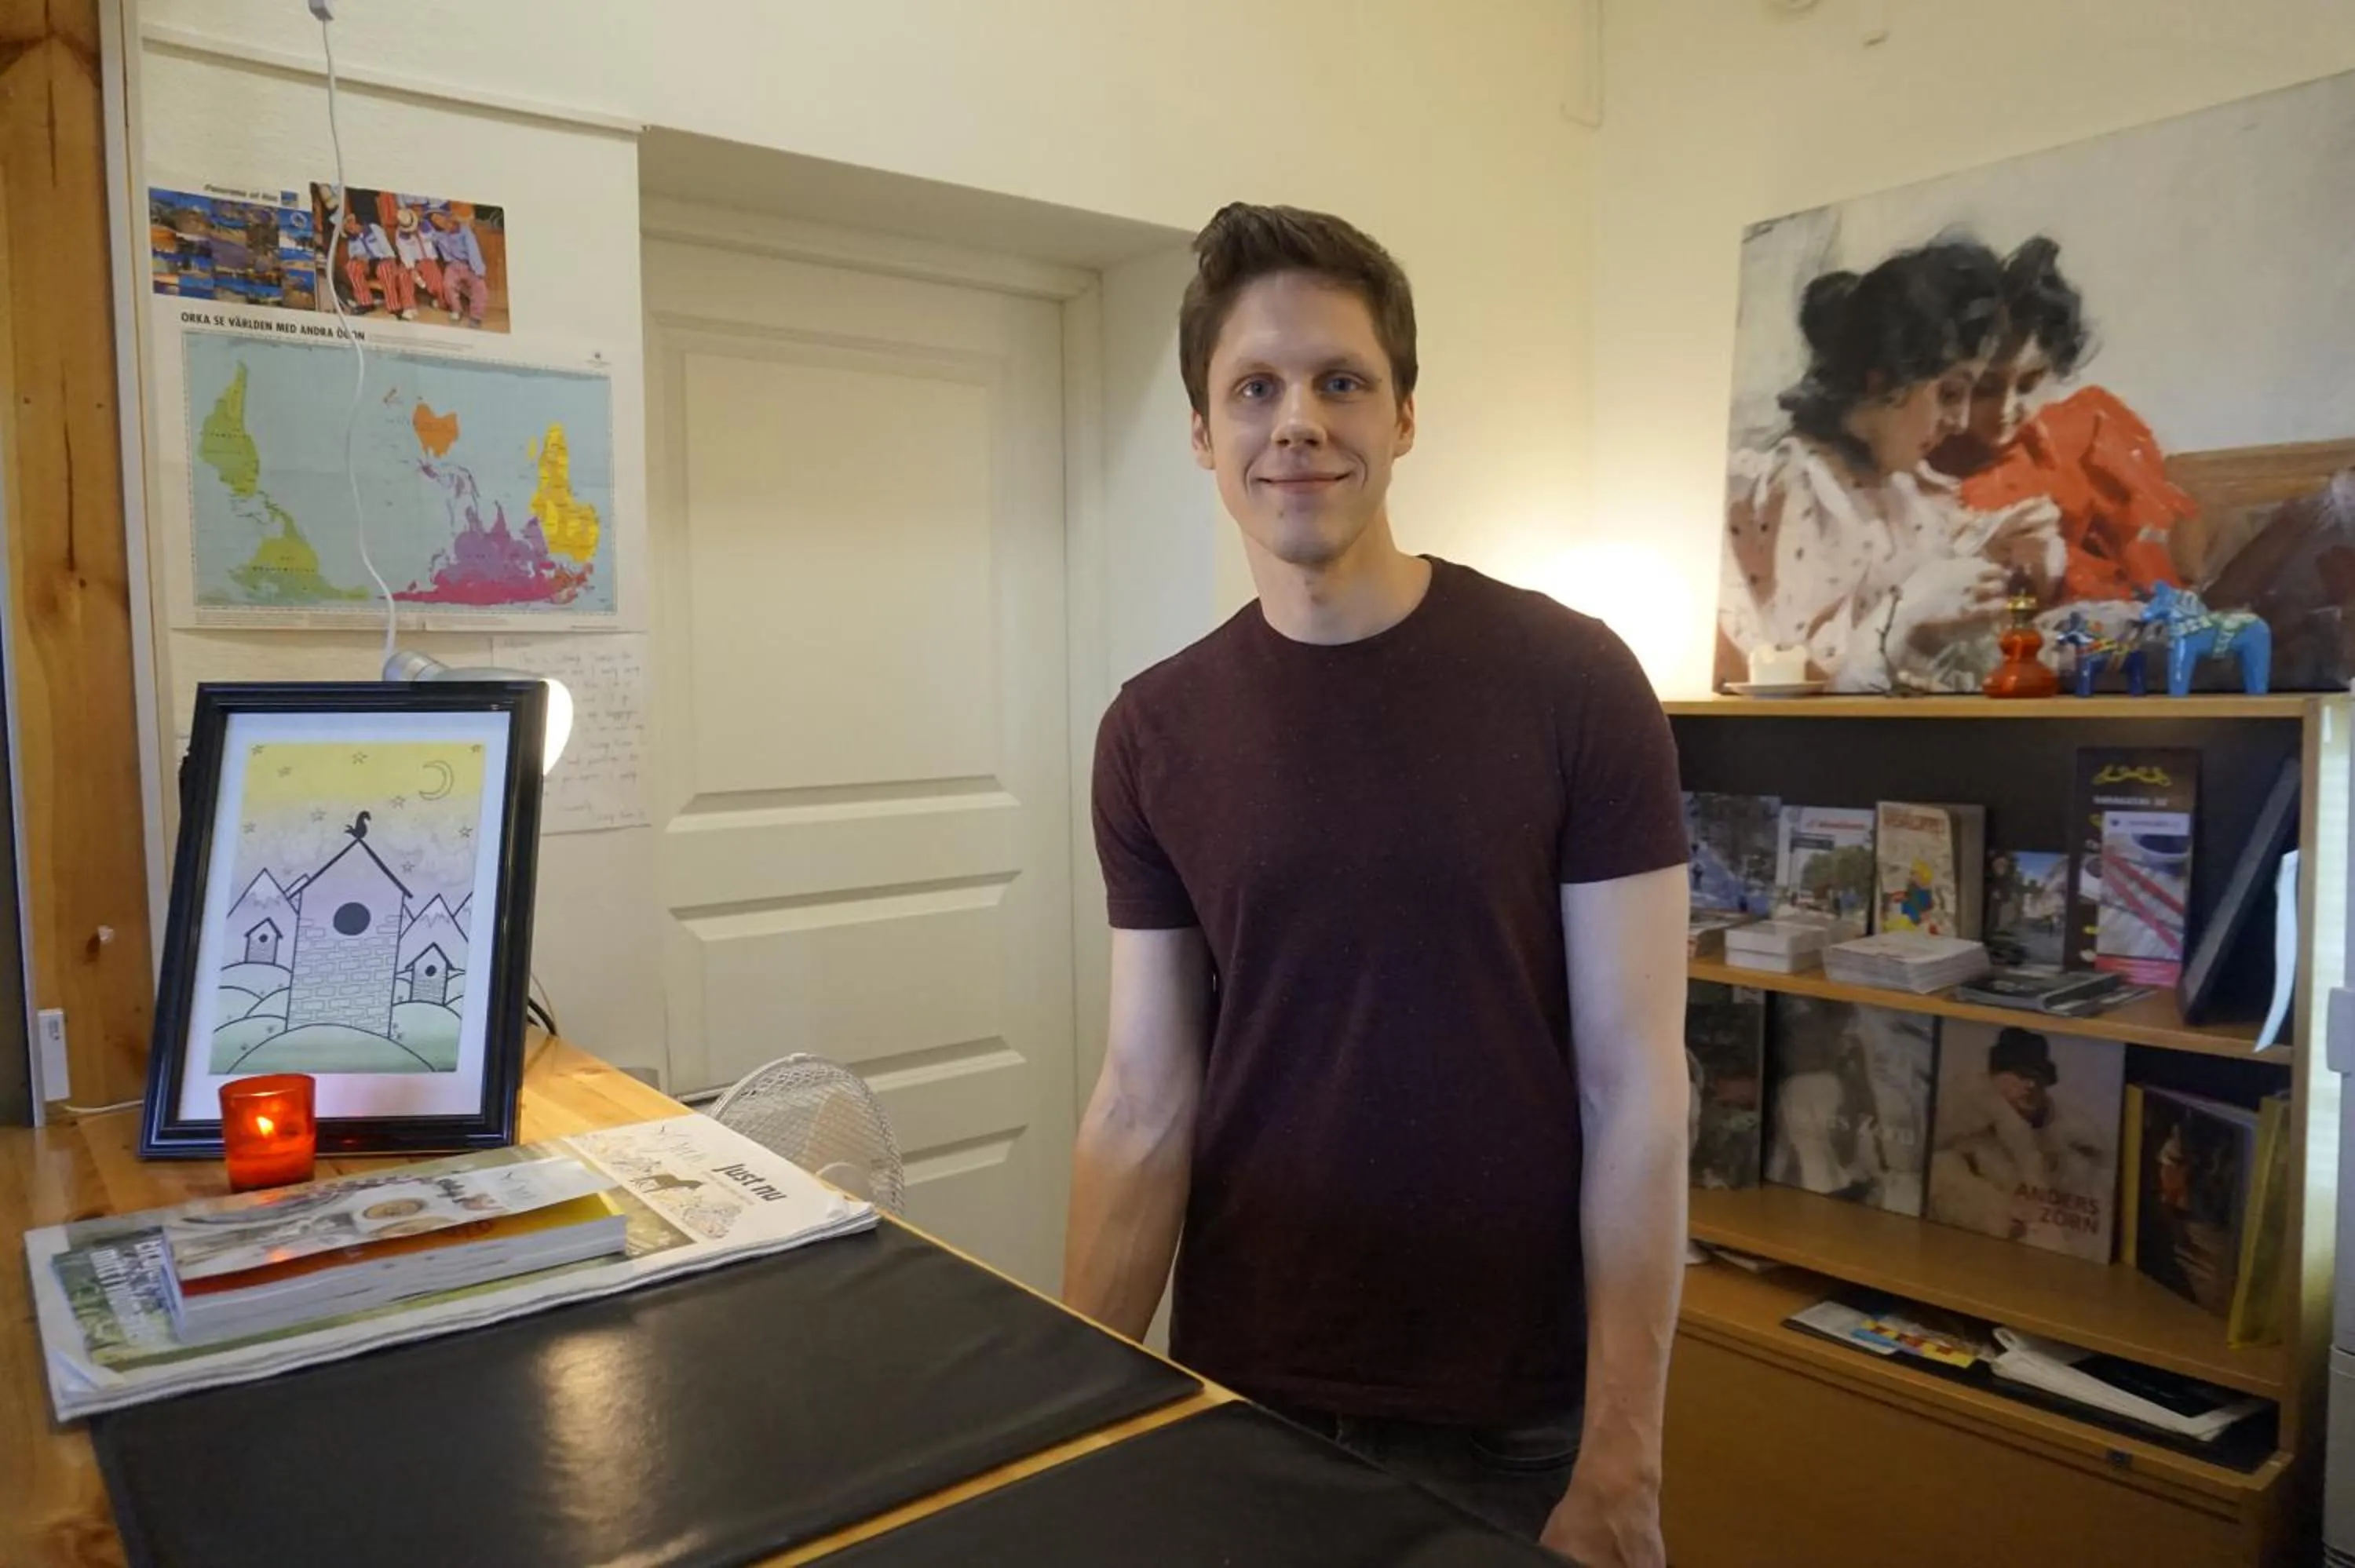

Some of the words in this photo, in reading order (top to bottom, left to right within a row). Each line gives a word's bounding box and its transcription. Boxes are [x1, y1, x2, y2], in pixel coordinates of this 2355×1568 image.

[181, 312, 211, 324] ORKA
[213, 315, 225, 326] SE
[228, 316, 273, 330] VÄRLDEN
[276, 322, 297, 334] MED
[300, 324, 334, 337] ANDRA
[750, 1185, 787, 1202] nu
[2014, 1182, 2101, 1216] ANDERS
[2039, 1207, 2100, 1235] ZORN
